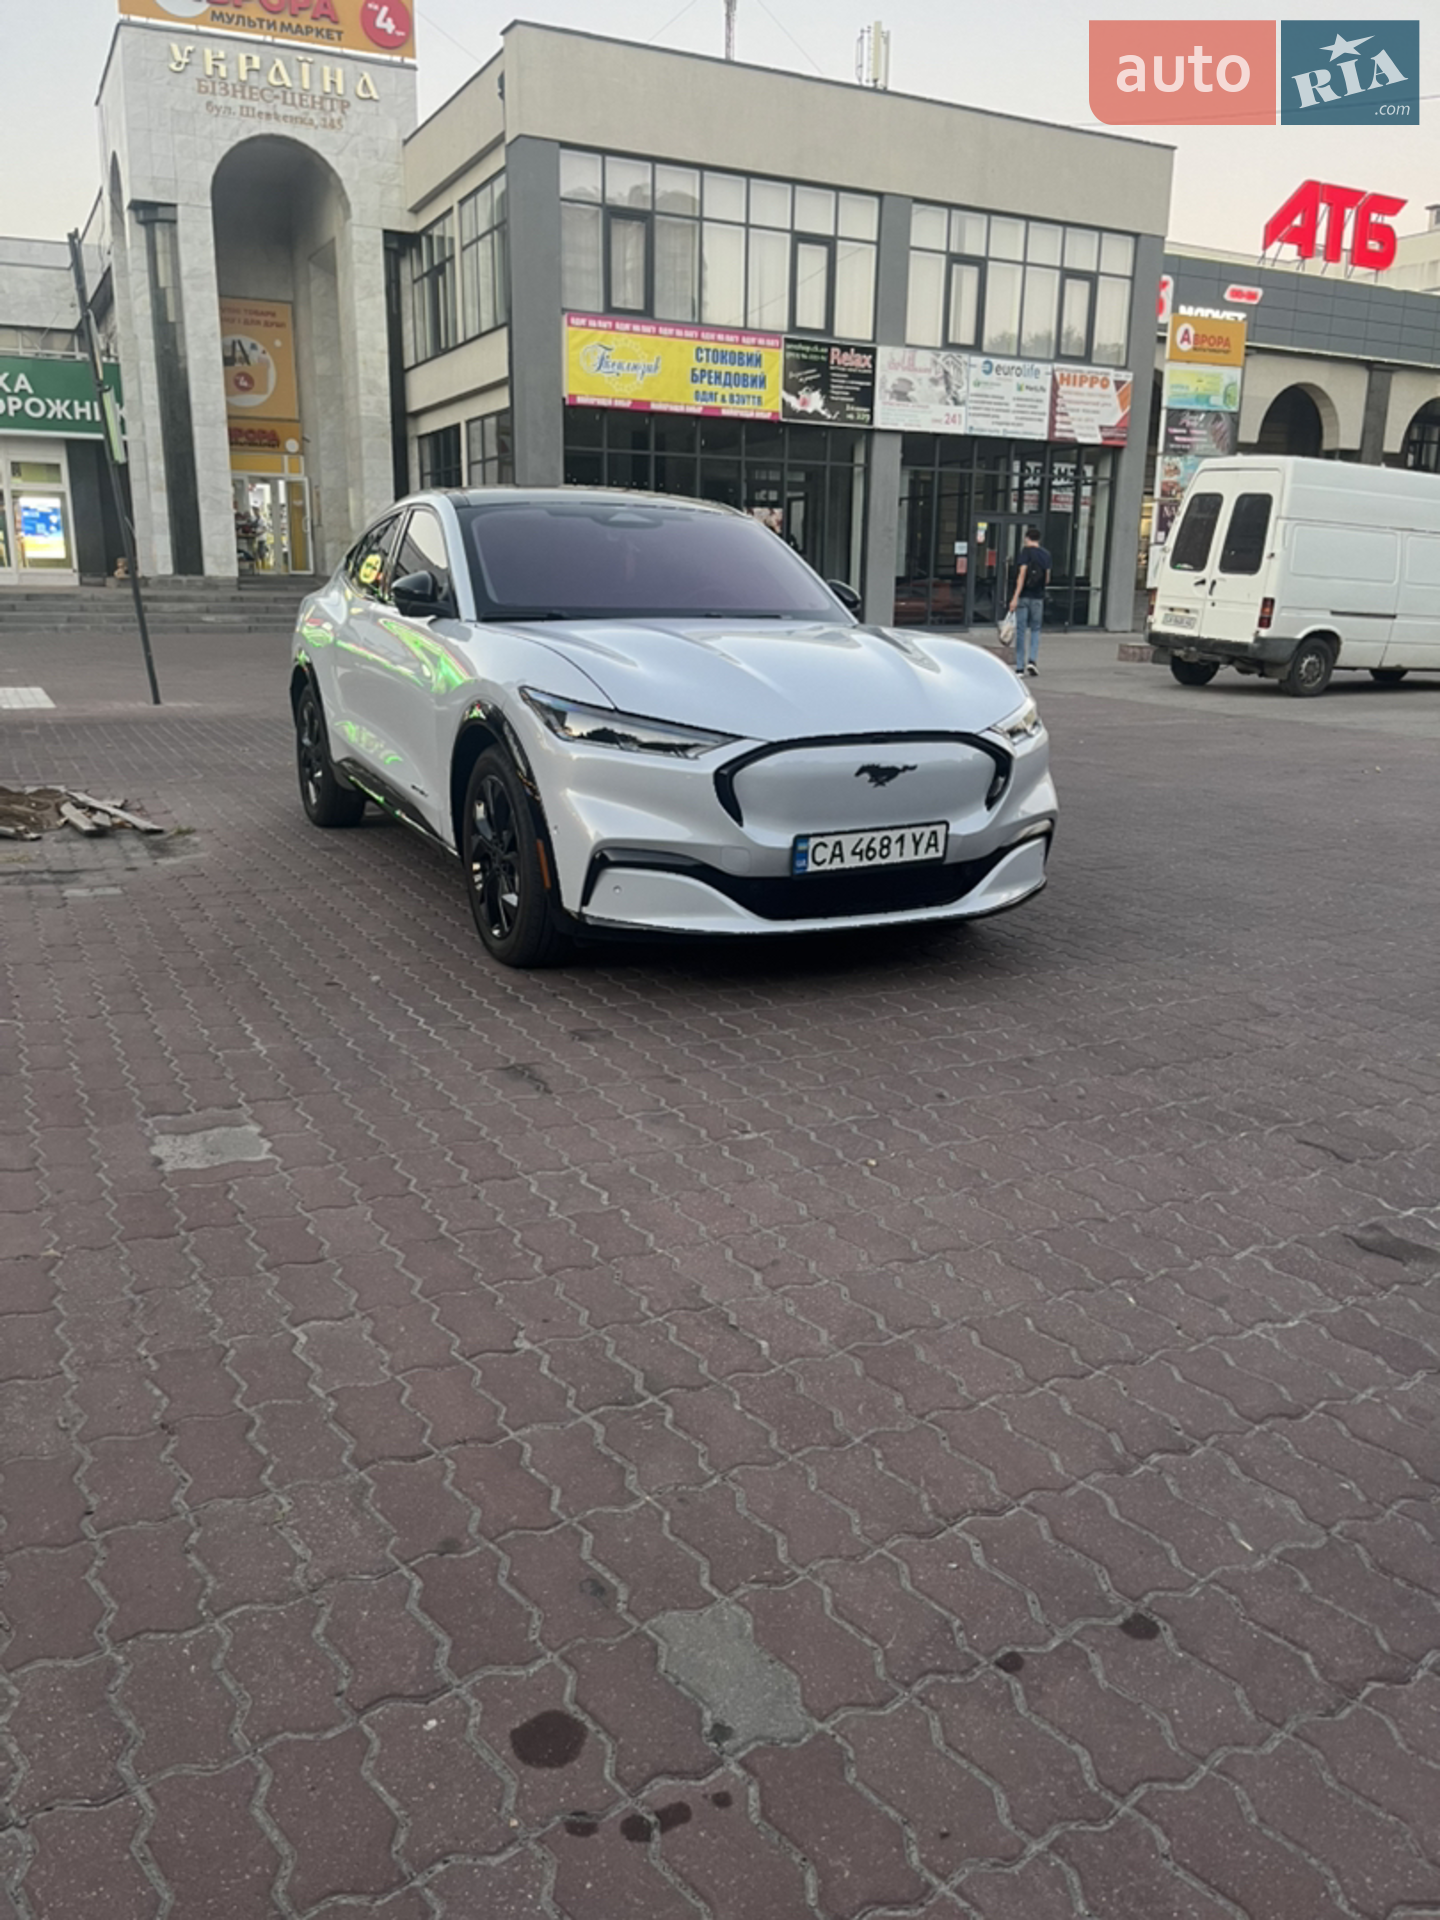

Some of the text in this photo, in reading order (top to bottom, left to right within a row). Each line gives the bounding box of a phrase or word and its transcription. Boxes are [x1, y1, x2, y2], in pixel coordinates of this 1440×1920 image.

[375, 5, 396, 35] 4
[279, 22, 344, 41] МАРКЕТ
[168, 43, 380, 101] УКРАЇНА
[195, 78, 351, 115] БІЗНЕС-ЦЕНТР
[205, 101, 236, 117] бул.
[1262, 178, 1409, 271] АТБ
[1180, 328, 1231, 349] АВРОРА
[695, 346, 762, 368] СТОКОВИЙ
[830, 347, 872, 368] Relax
[690, 367, 766, 389] БРЕНДОВИЙ
[995, 363, 1040, 379] eurolife
[1059, 372, 1110, 390] HIPPO
[694, 390, 718, 404] ОДЯГ
[729, 393, 763, 406] ВЗУТТЯ
[944, 412, 962, 425] 241
[811, 830, 940, 867] CA 4681 YA
